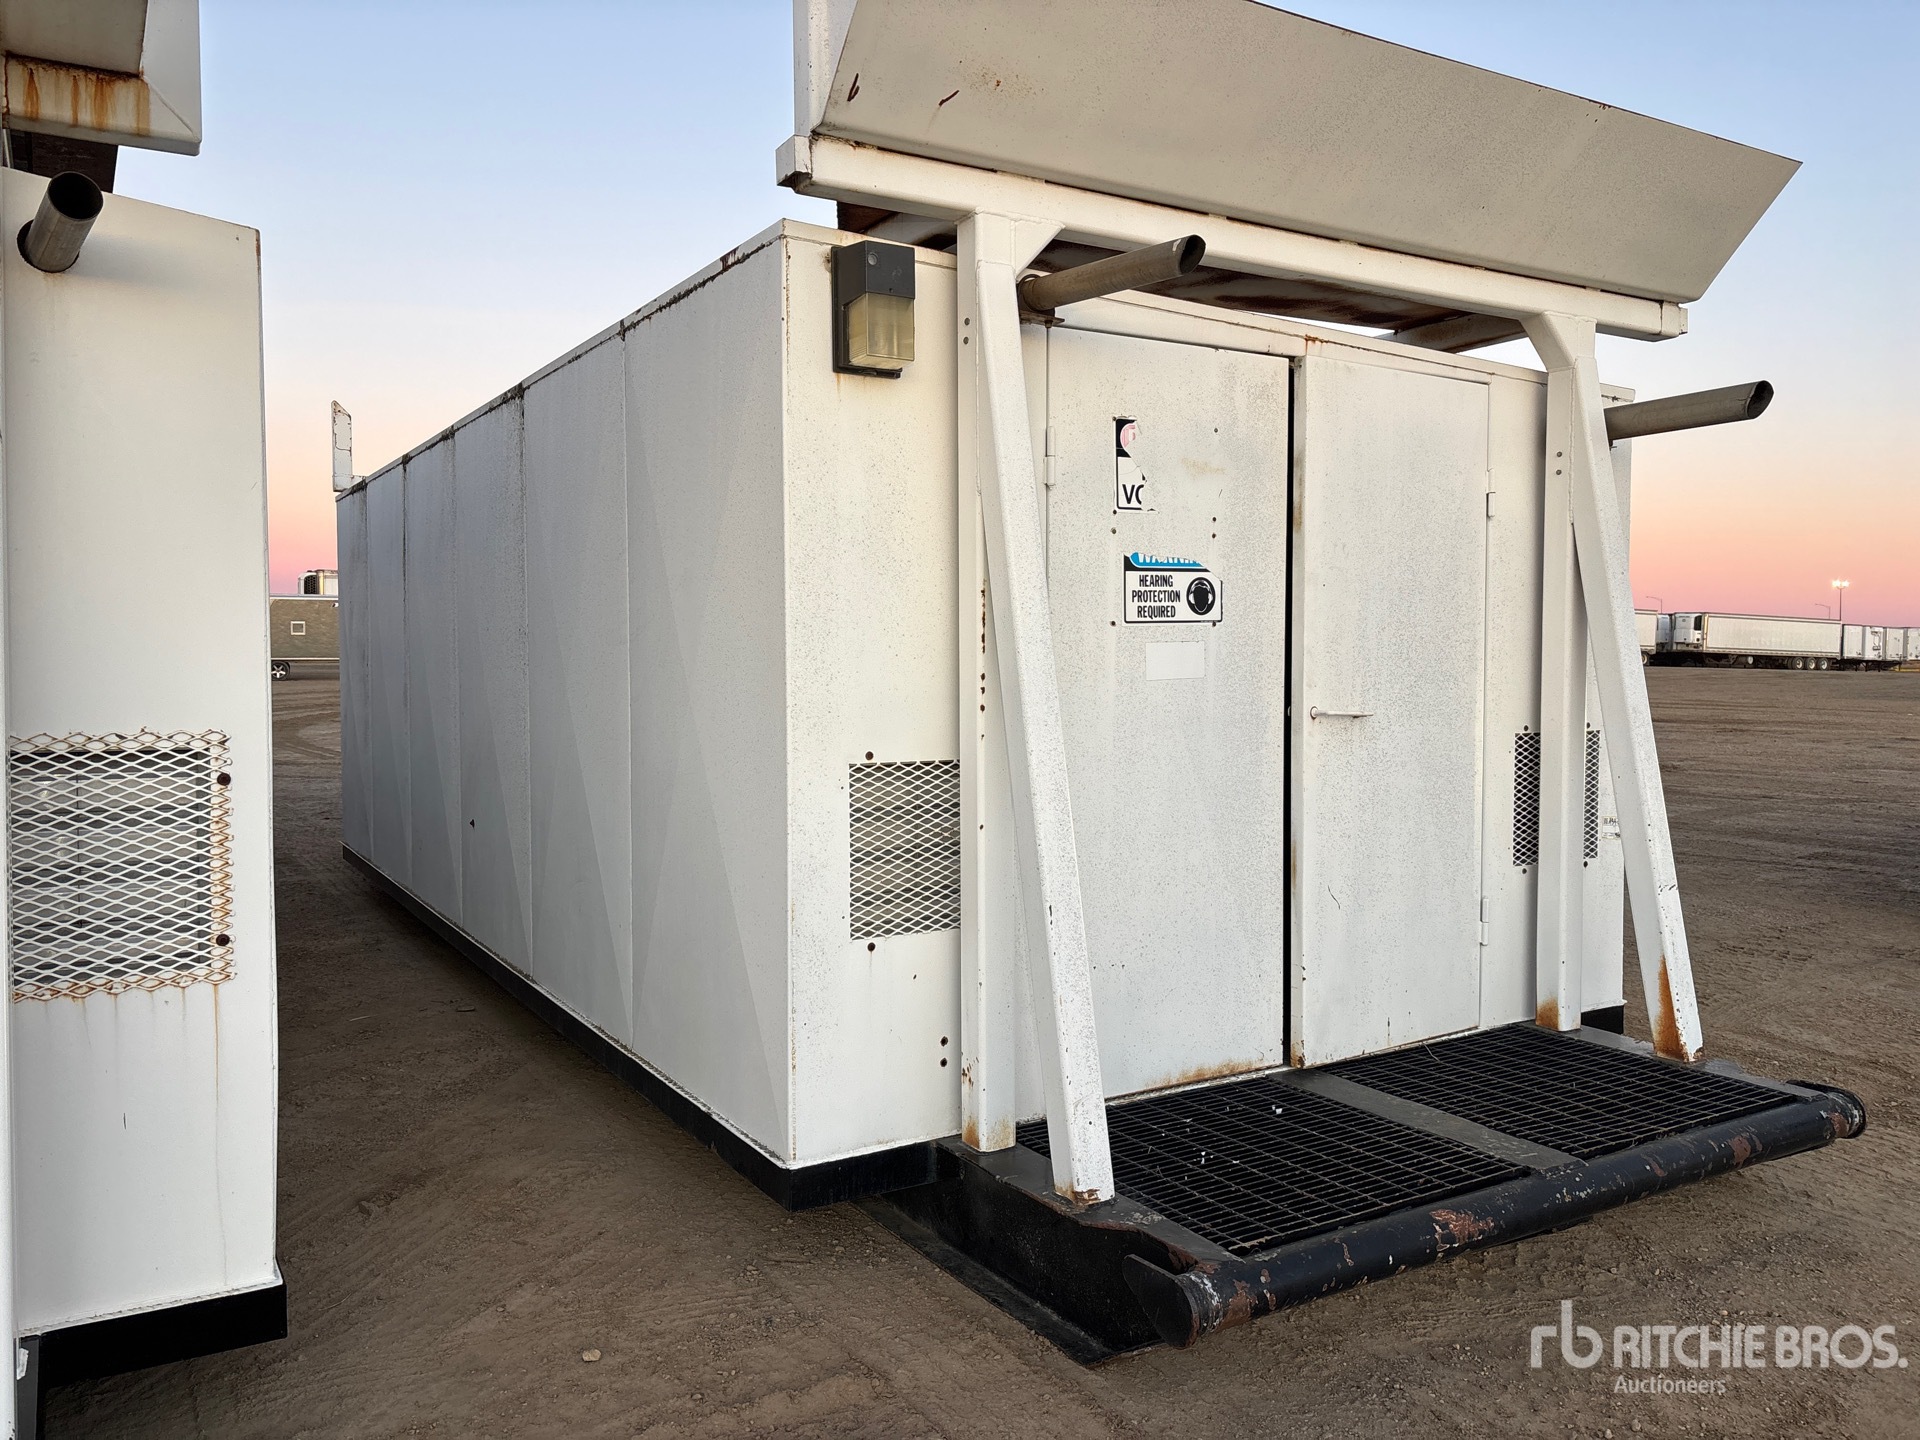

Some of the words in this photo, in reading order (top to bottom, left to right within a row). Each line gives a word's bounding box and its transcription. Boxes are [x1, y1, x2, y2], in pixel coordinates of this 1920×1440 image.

[1139, 574, 1173, 588] HEARING
[1131, 590, 1181, 603] PROTECTION
[1137, 605, 1176, 619] REQUIRED
